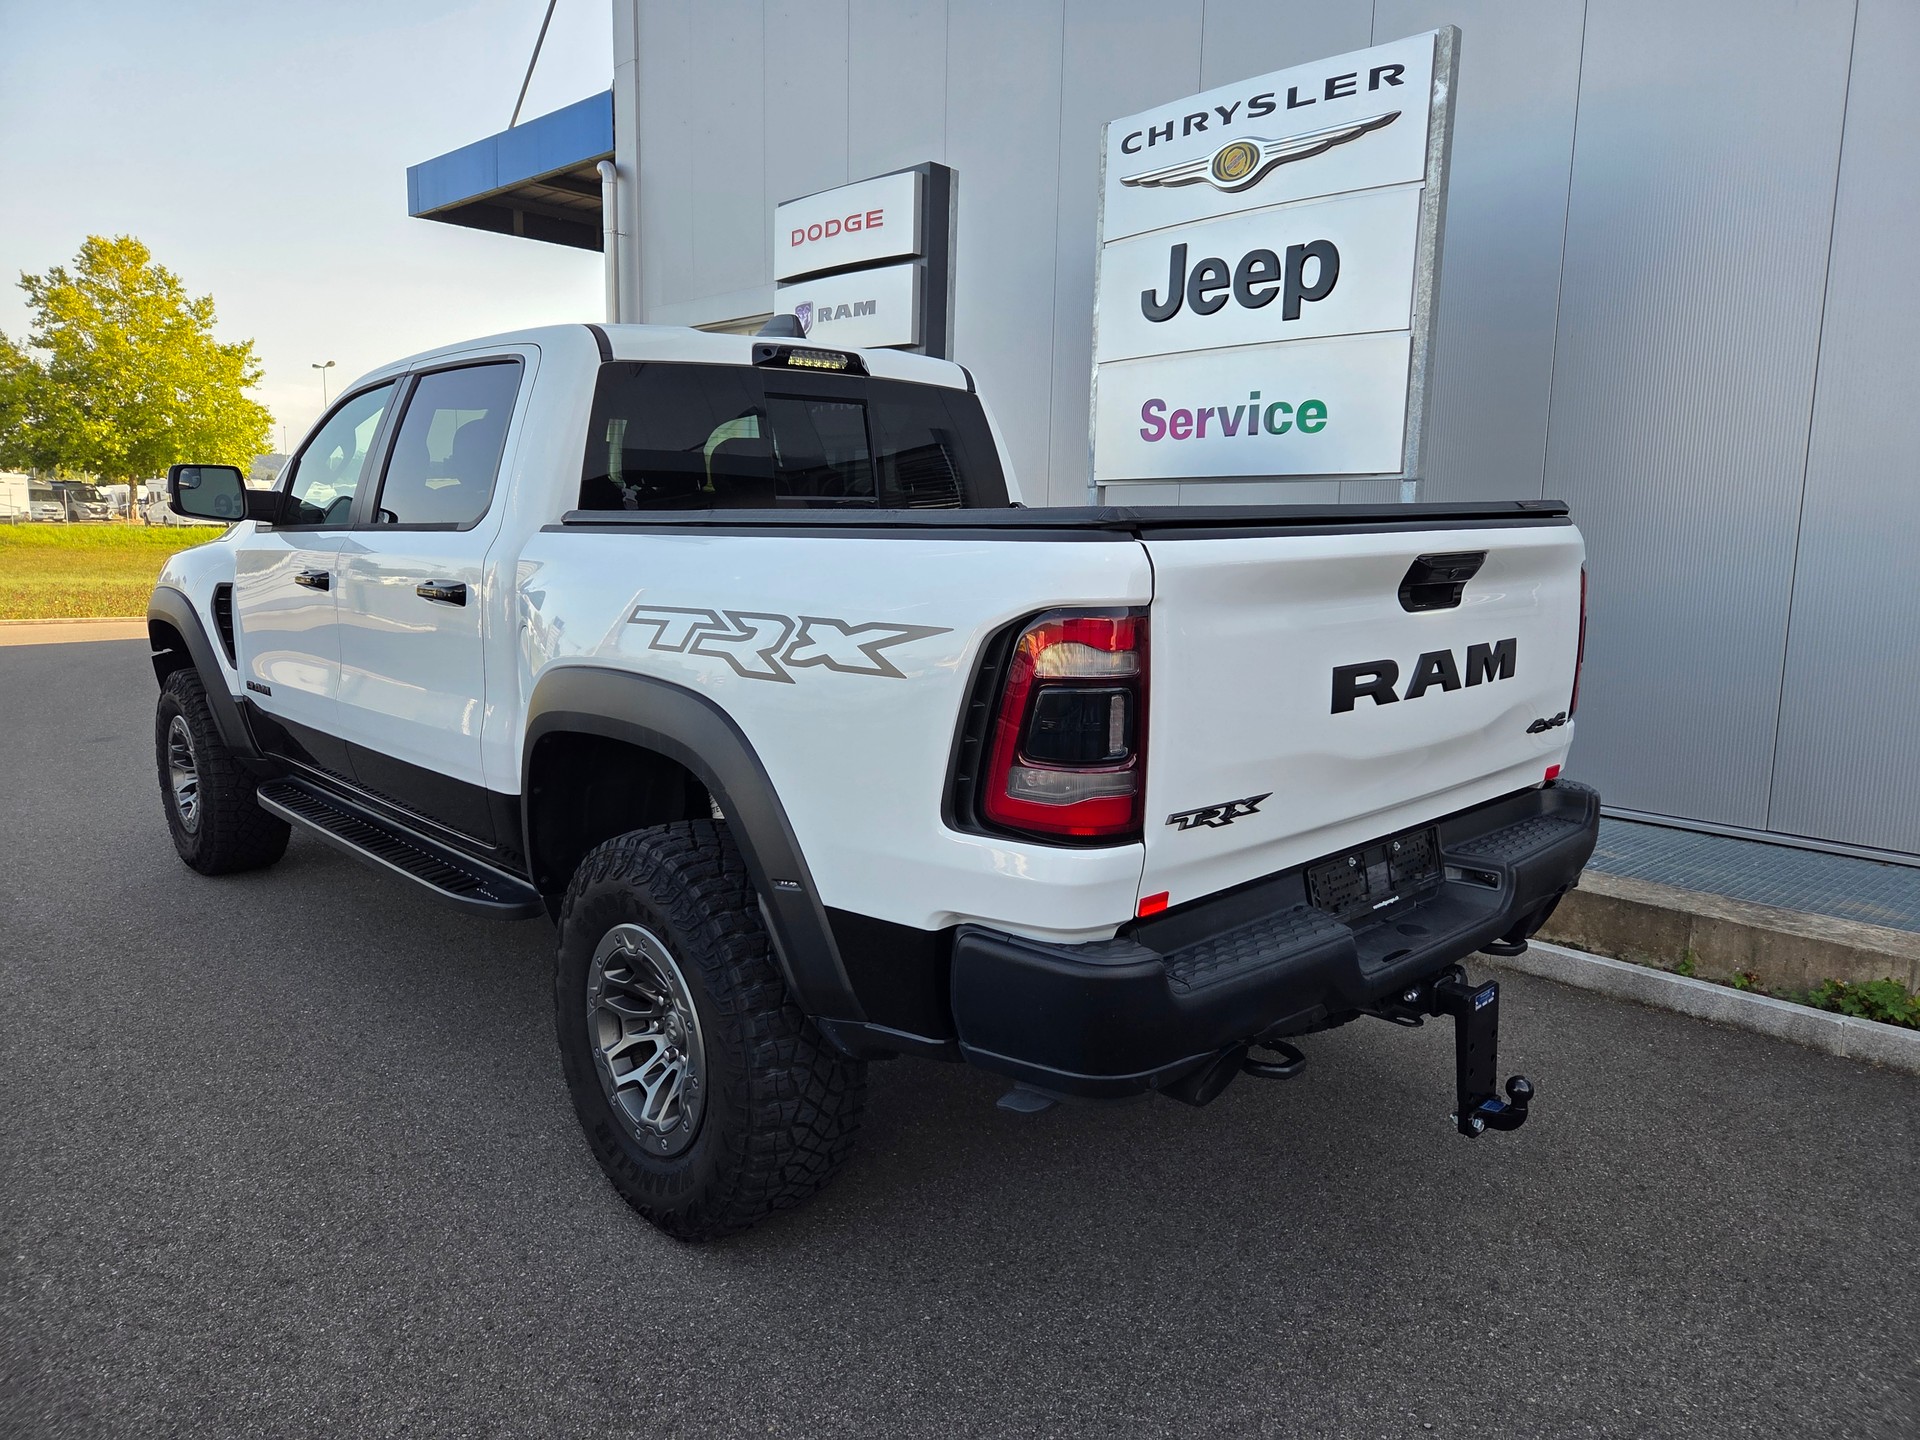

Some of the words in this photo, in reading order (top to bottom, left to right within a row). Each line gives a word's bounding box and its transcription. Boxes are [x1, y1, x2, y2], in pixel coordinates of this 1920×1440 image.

[1120, 63, 1405, 154] CHRYSLER
[791, 209, 884, 247] DODGE
[1141, 239, 1340, 322] Jeep
[817, 299, 877, 323] RAM
[1140, 391, 1328, 442] Service
[627, 604, 954, 684] TRX
[246, 680, 272, 697] RAM
[1330, 637, 1517, 715] RAM
[1165, 792, 1274, 831] TRX
